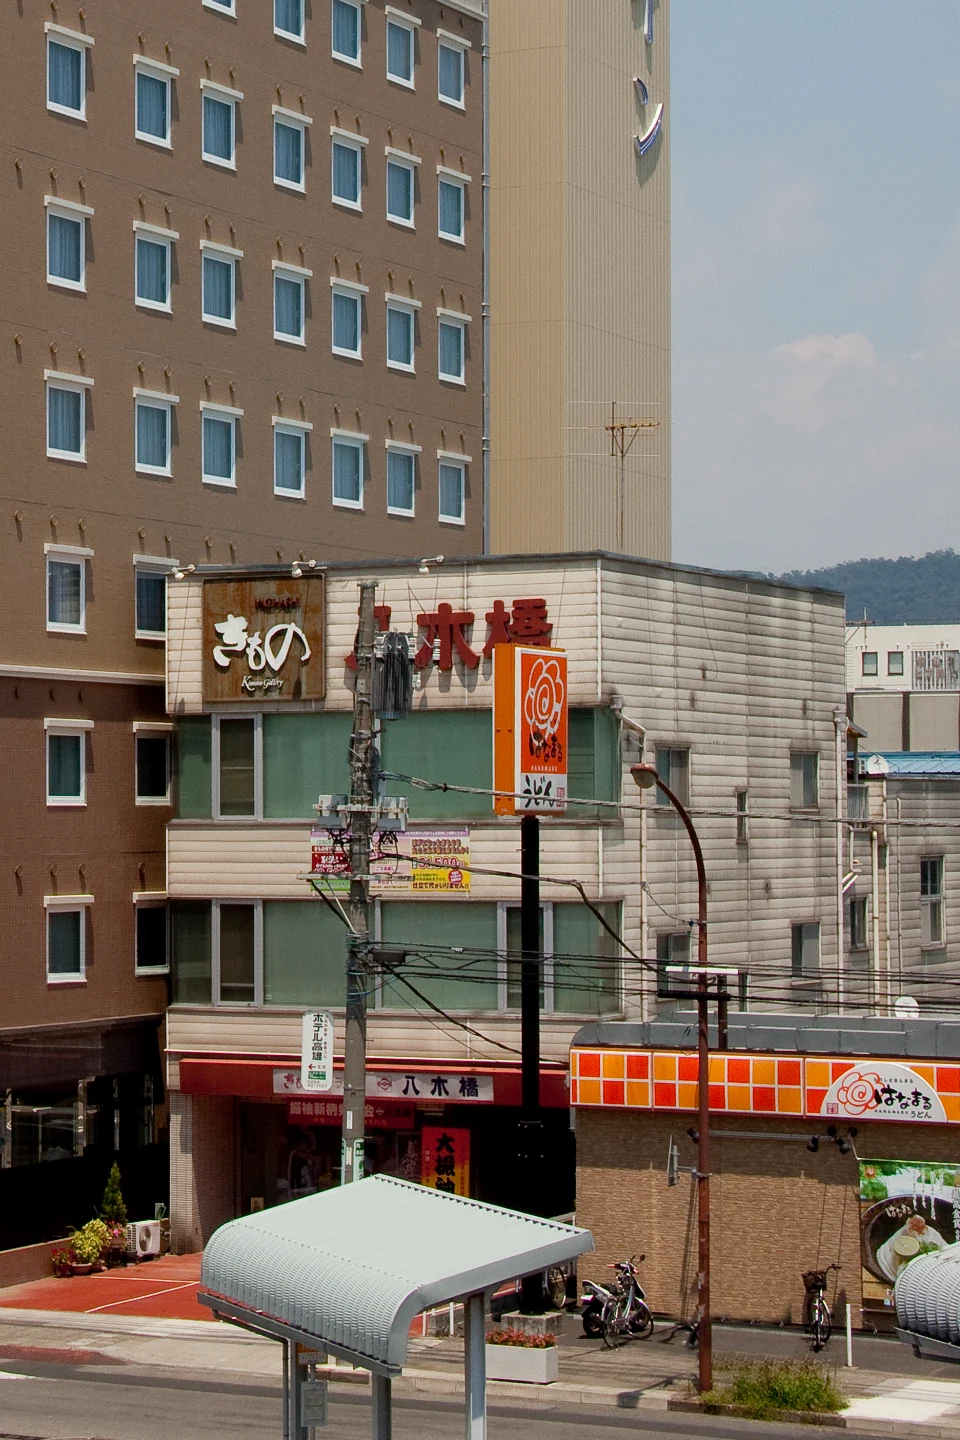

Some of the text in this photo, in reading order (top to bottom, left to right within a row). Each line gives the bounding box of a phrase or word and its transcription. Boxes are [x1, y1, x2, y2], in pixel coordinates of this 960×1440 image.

[213, 614, 311, 671] きもの
[312, 1013, 324, 1061] ホテル高雄
[402, 1075, 479, 1097] 八木橋
[874, 1084, 932, 1110] はなまる
[911, 1110, 932, 1119] うどん
